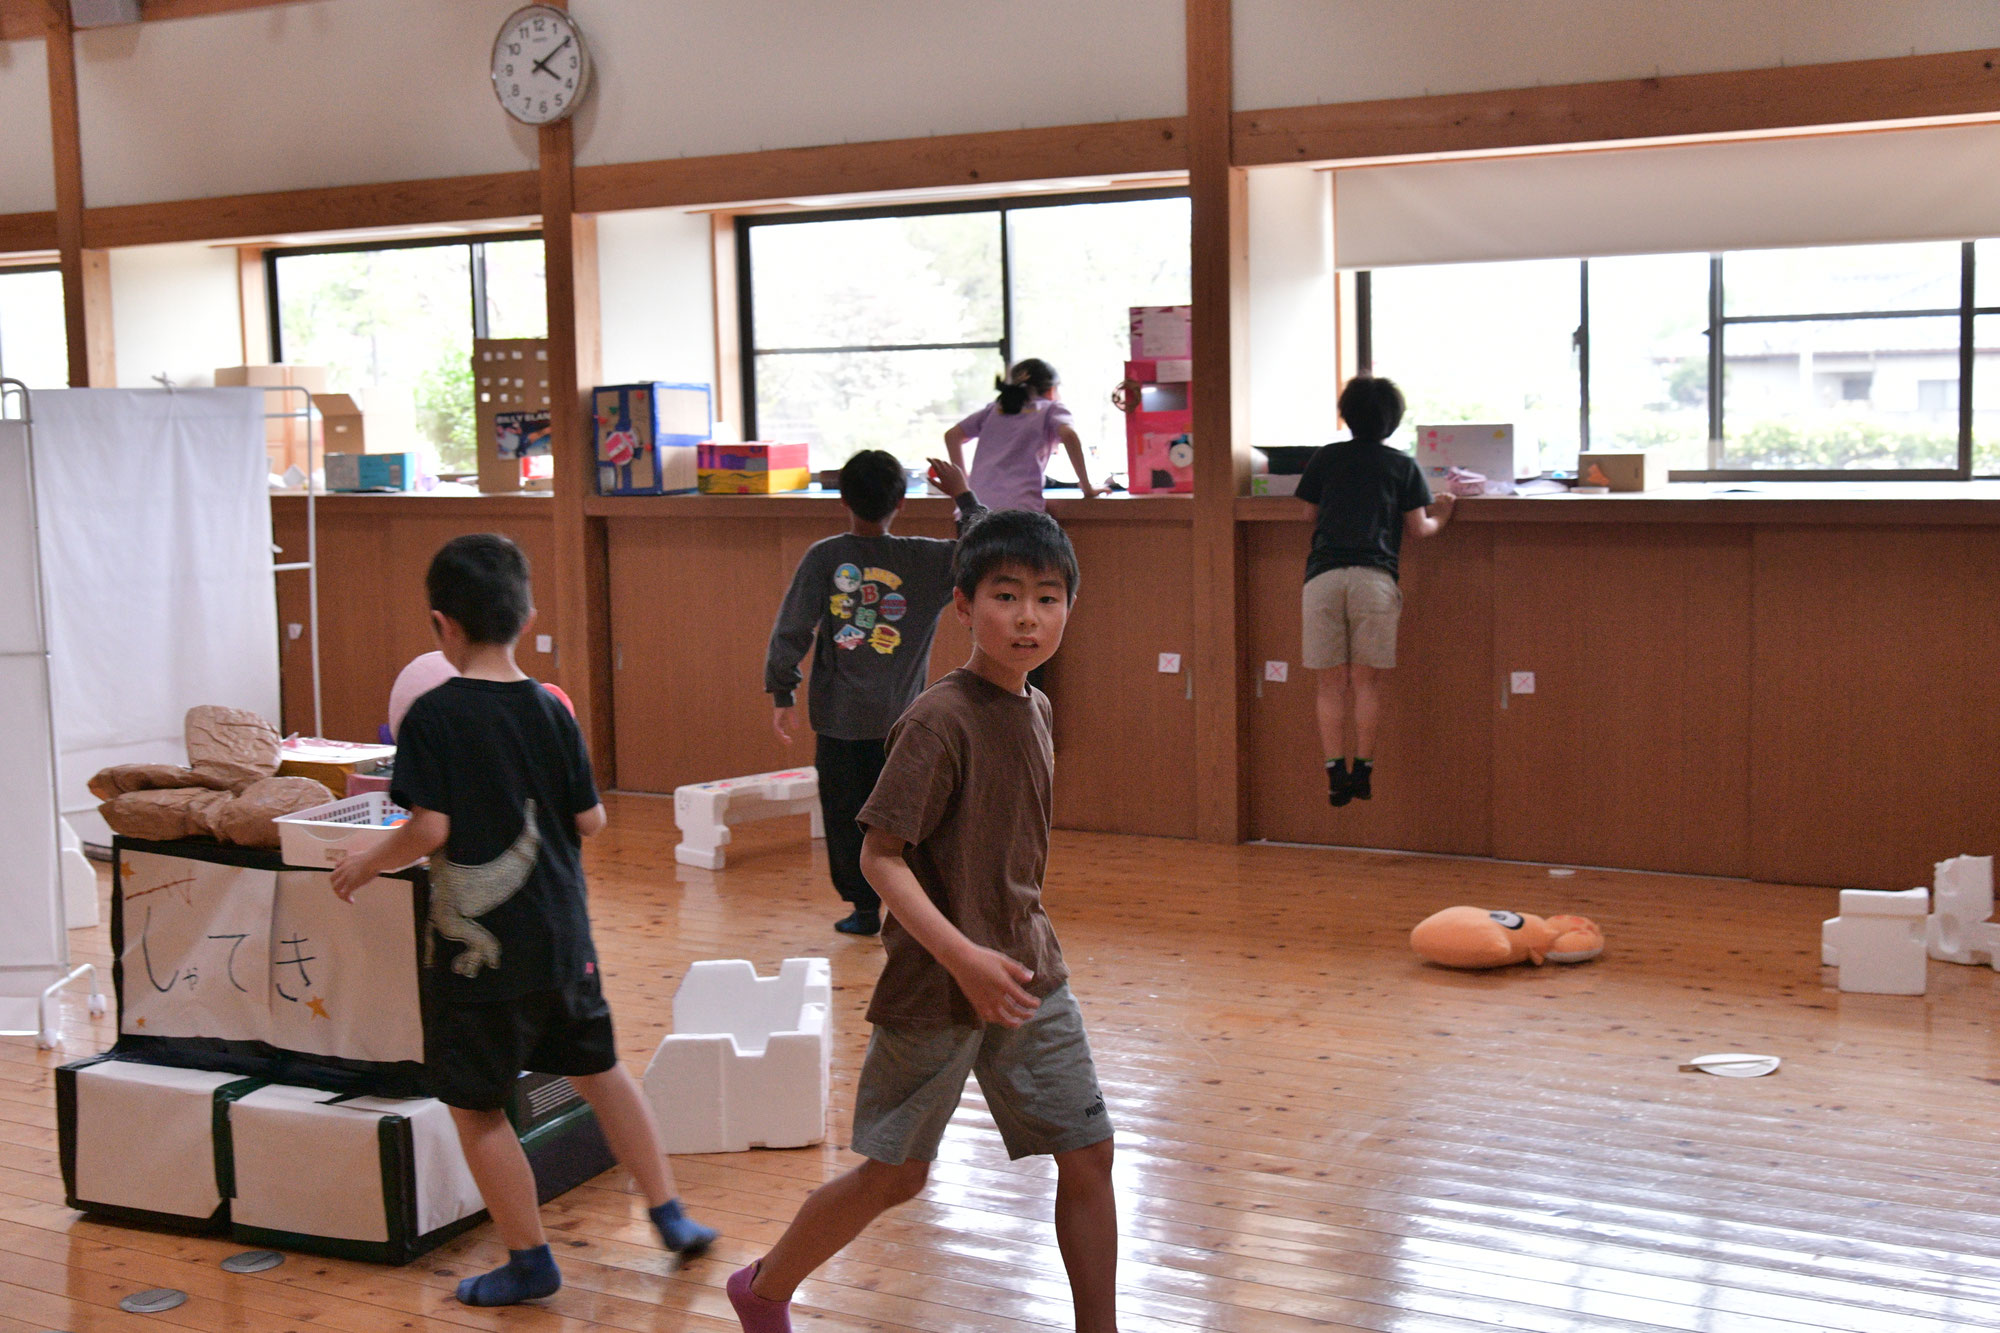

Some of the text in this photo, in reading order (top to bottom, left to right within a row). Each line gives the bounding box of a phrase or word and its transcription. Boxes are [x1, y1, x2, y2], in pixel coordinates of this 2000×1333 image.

[533, 19, 545, 32] 12
[520, 27, 529, 39] 11
[509, 43, 520, 56] 10
[570, 56, 577, 69] 3
[506, 64, 514, 77] 9
[565, 78, 573, 89] 4
[512, 84, 520, 97] 8
[525, 97, 532, 110] 7
[555, 94, 563, 107] 5
[539, 101, 548, 114] 6
[861, 584, 879, 604] B
[142, 904, 316, 1002] しゃてき
[1085, 1101, 1106, 1118] PUM
